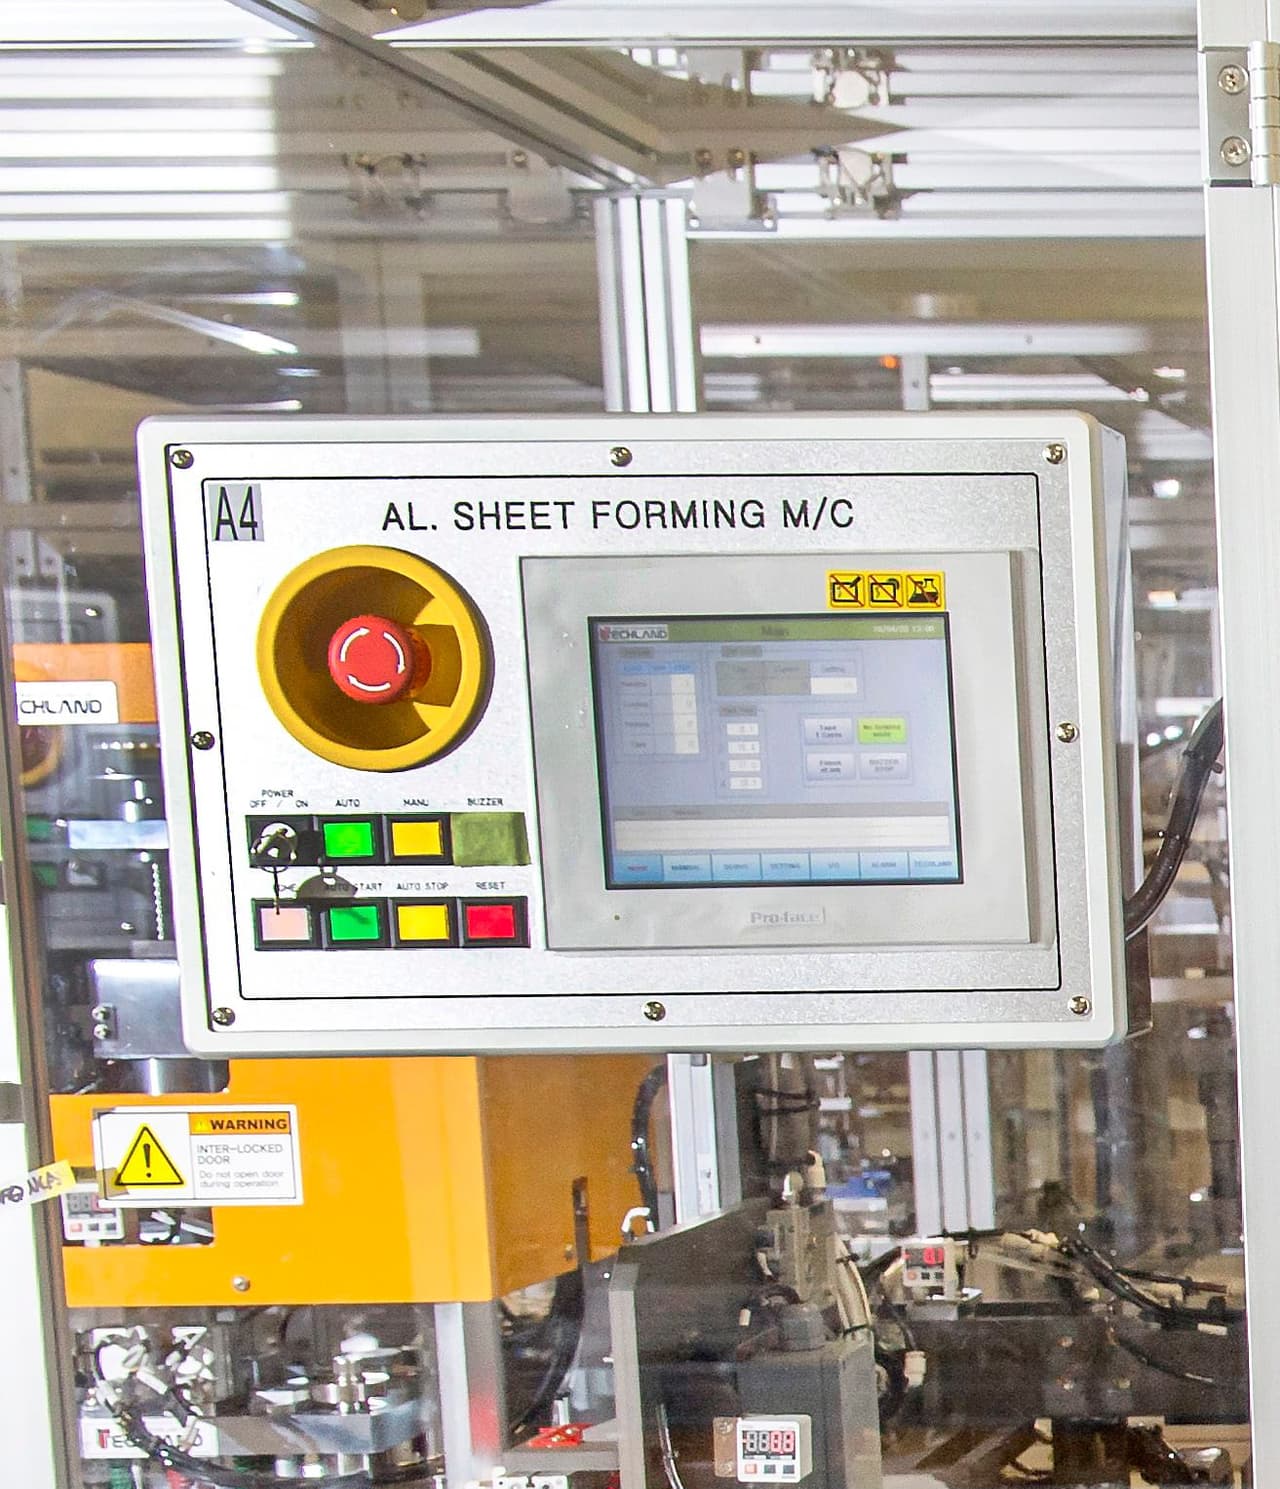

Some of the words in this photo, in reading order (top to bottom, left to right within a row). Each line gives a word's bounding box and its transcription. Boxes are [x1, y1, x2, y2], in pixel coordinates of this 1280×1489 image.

[214, 485, 259, 541] A4
[382, 502, 437, 531] AL.
[453, 500, 575, 531] SHEET
[592, 499, 765, 530] FORMING
[783, 497, 855, 531] M/C
[261, 789, 294, 798] POWER
[249, 799, 267, 808] OFF
[295, 799, 309, 808] ON
[335, 798, 361, 808] AUTO
[466, 797, 504, 806] BUZZER
[396, 882, 421, 891] AUTO
[425, 881, 449, 891] STOP
[475, 881, 505, 890] RESET
[210, 1118, 288, 1131] WARNING
[196, 1143, 284, 1154] INTER-LOCKED
[197, 1154, 230, 1165] DOOR
